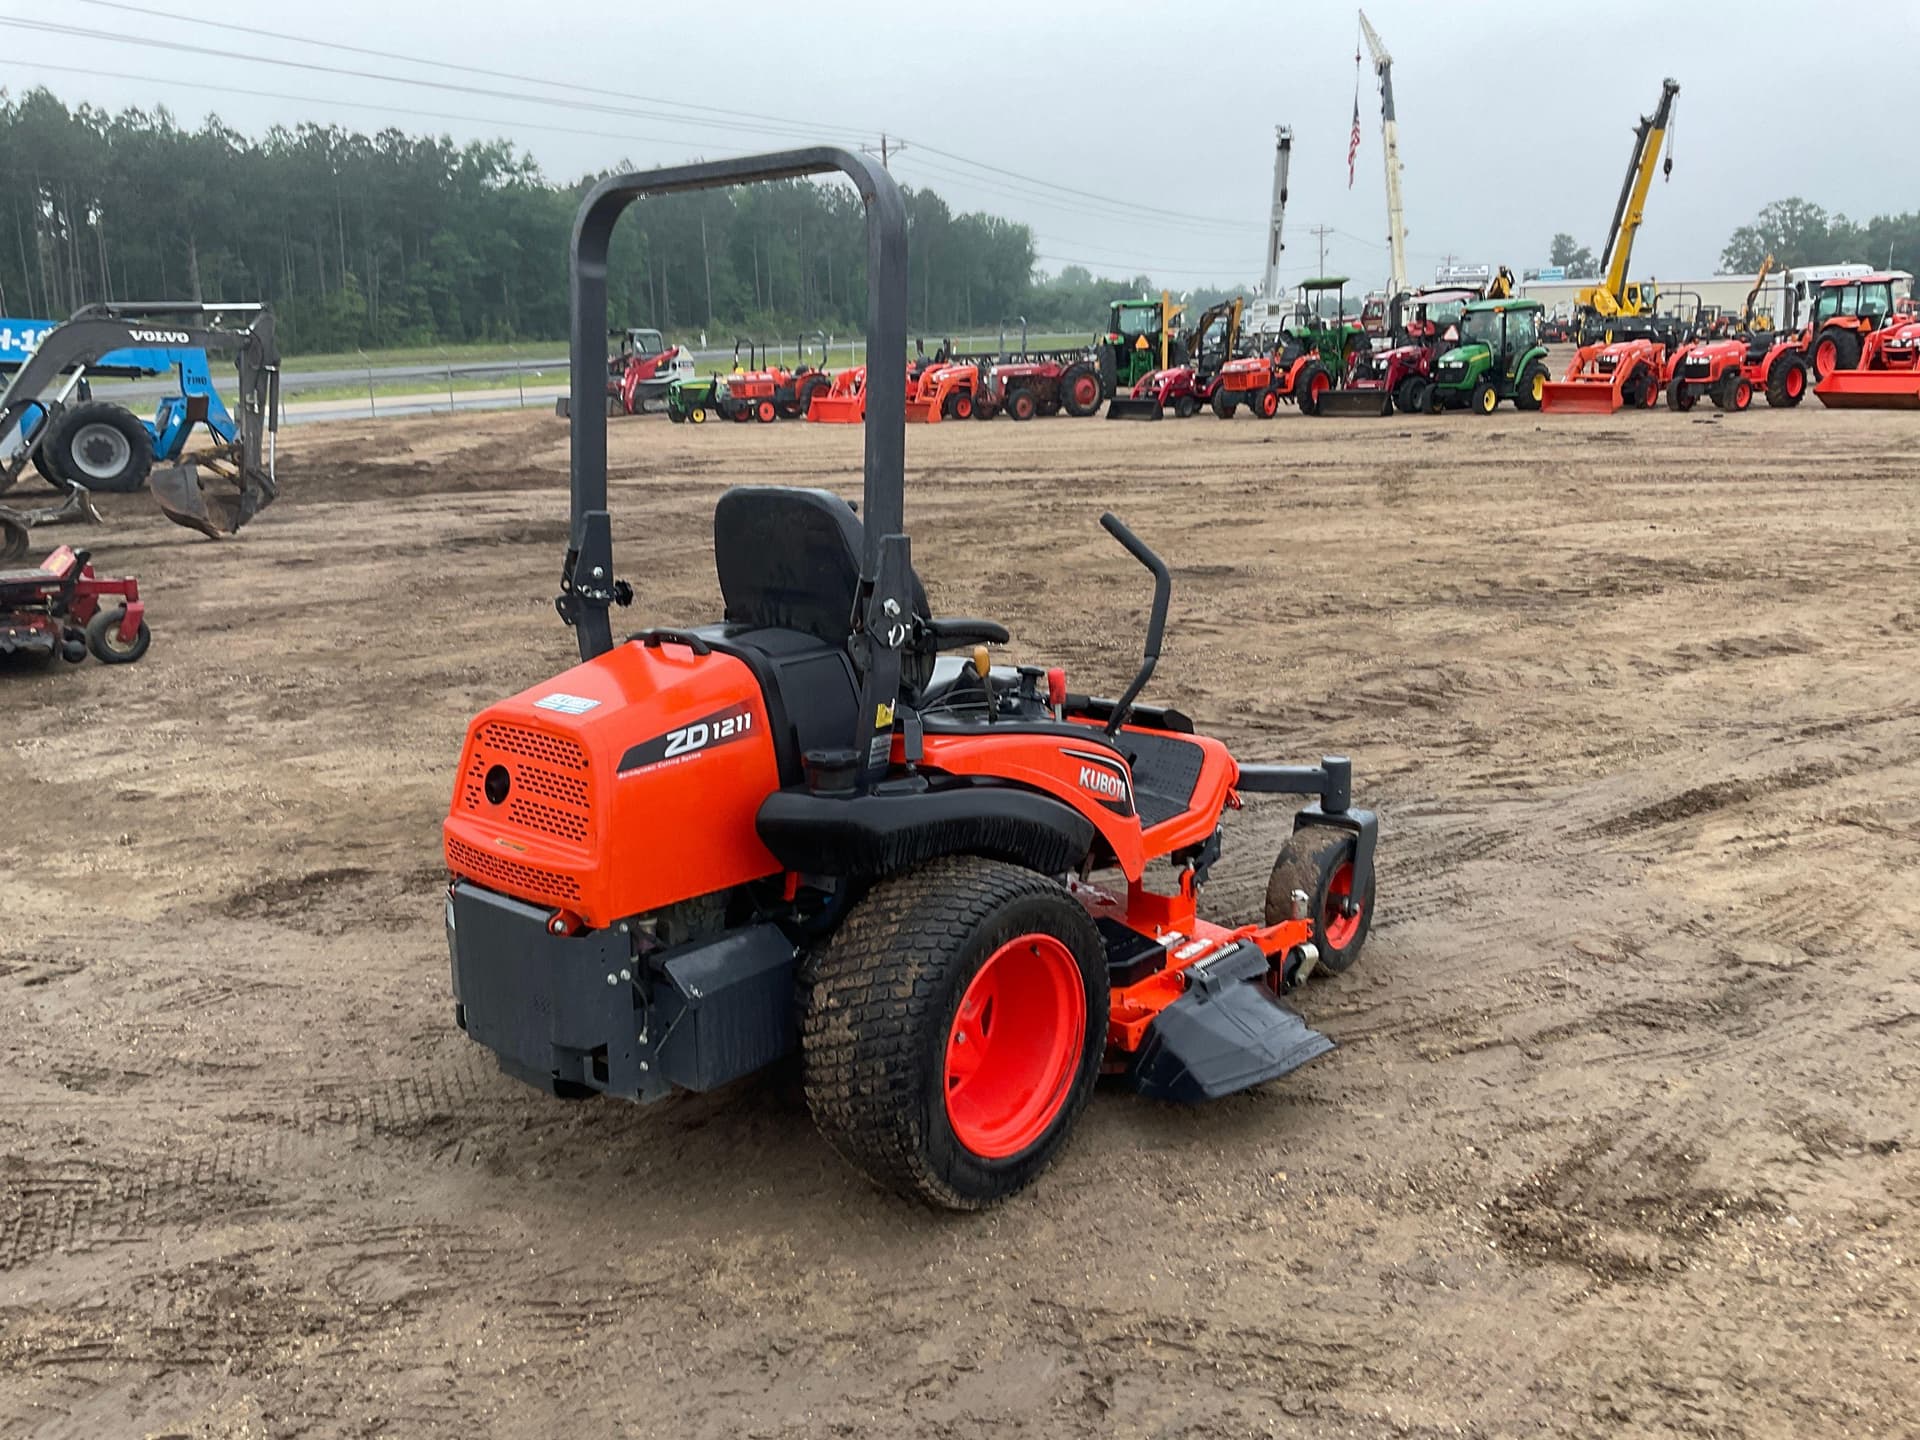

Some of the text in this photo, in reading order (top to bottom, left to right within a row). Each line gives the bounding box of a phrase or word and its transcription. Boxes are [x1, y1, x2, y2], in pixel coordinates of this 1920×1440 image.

[128, 330, 190, 343] VOLVO
[665, 712, 751, 758] ZD 1211
[1079, 766, 1126, 802] KUBOTA
